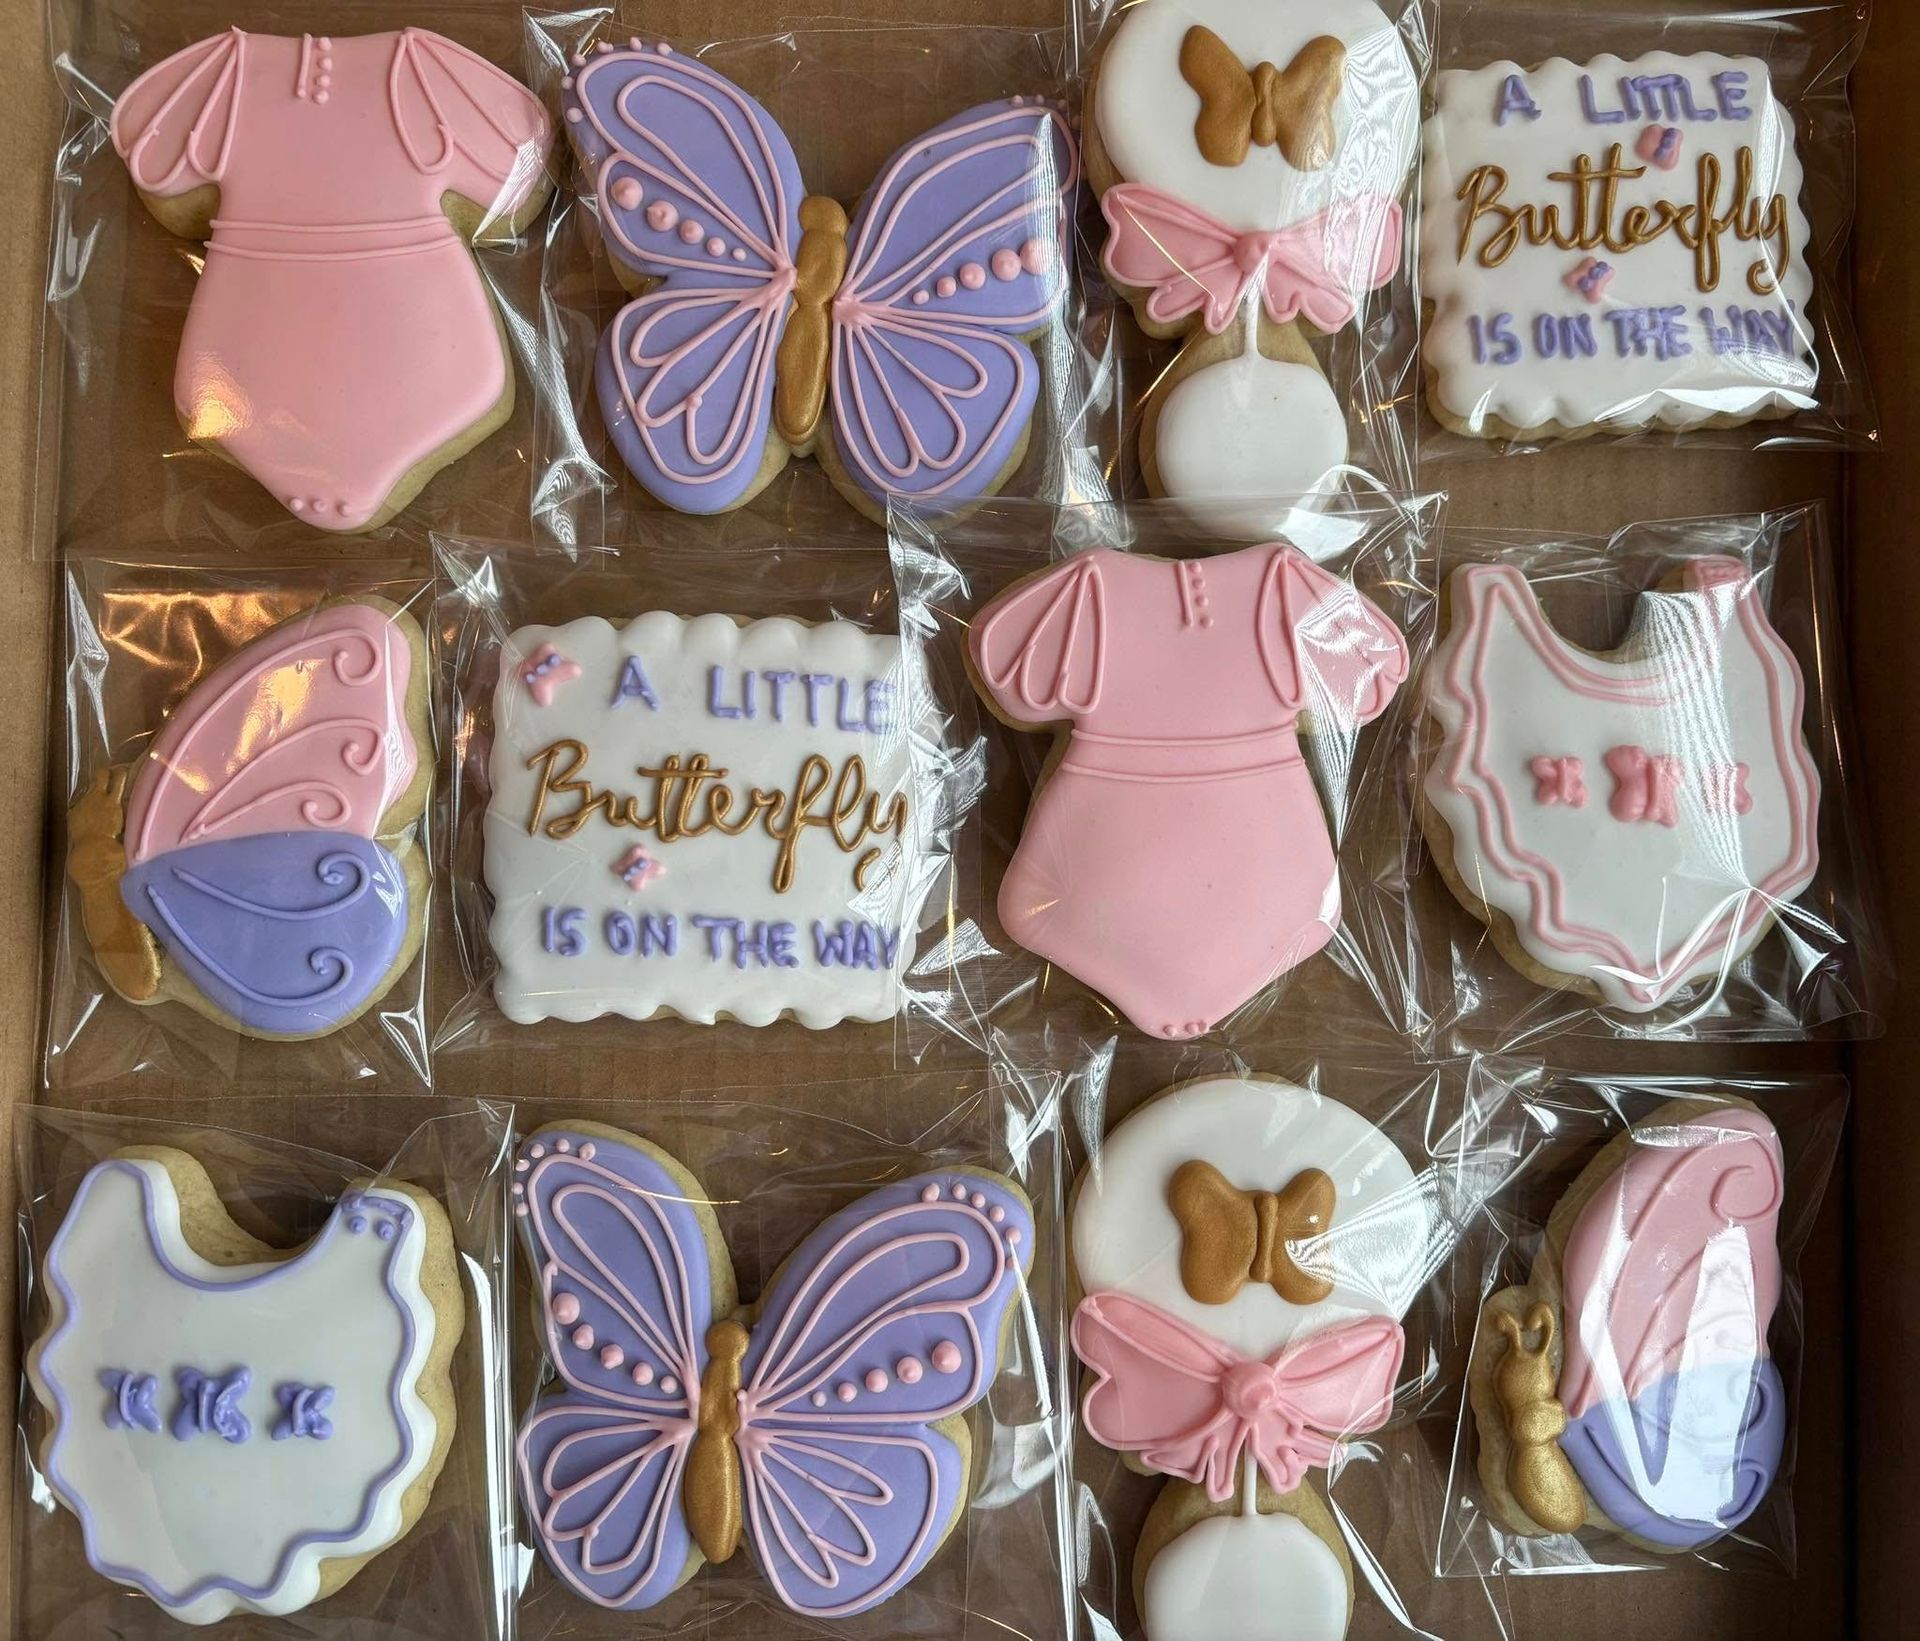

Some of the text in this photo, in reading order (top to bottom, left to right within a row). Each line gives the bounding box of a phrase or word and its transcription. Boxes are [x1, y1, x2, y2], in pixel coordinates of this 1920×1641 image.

[1496, 71, 1753, 125] A LITTLE
[1457, 143, 1790, 295] Butterfly
[1469, 299, 1796, 365] IS ON THE WAY
[610, 655, 899, 734] A LITTLE
[527, 739, 908, 893] Butterfly
[544, 906, 901, 970] IS ON THE WAY
